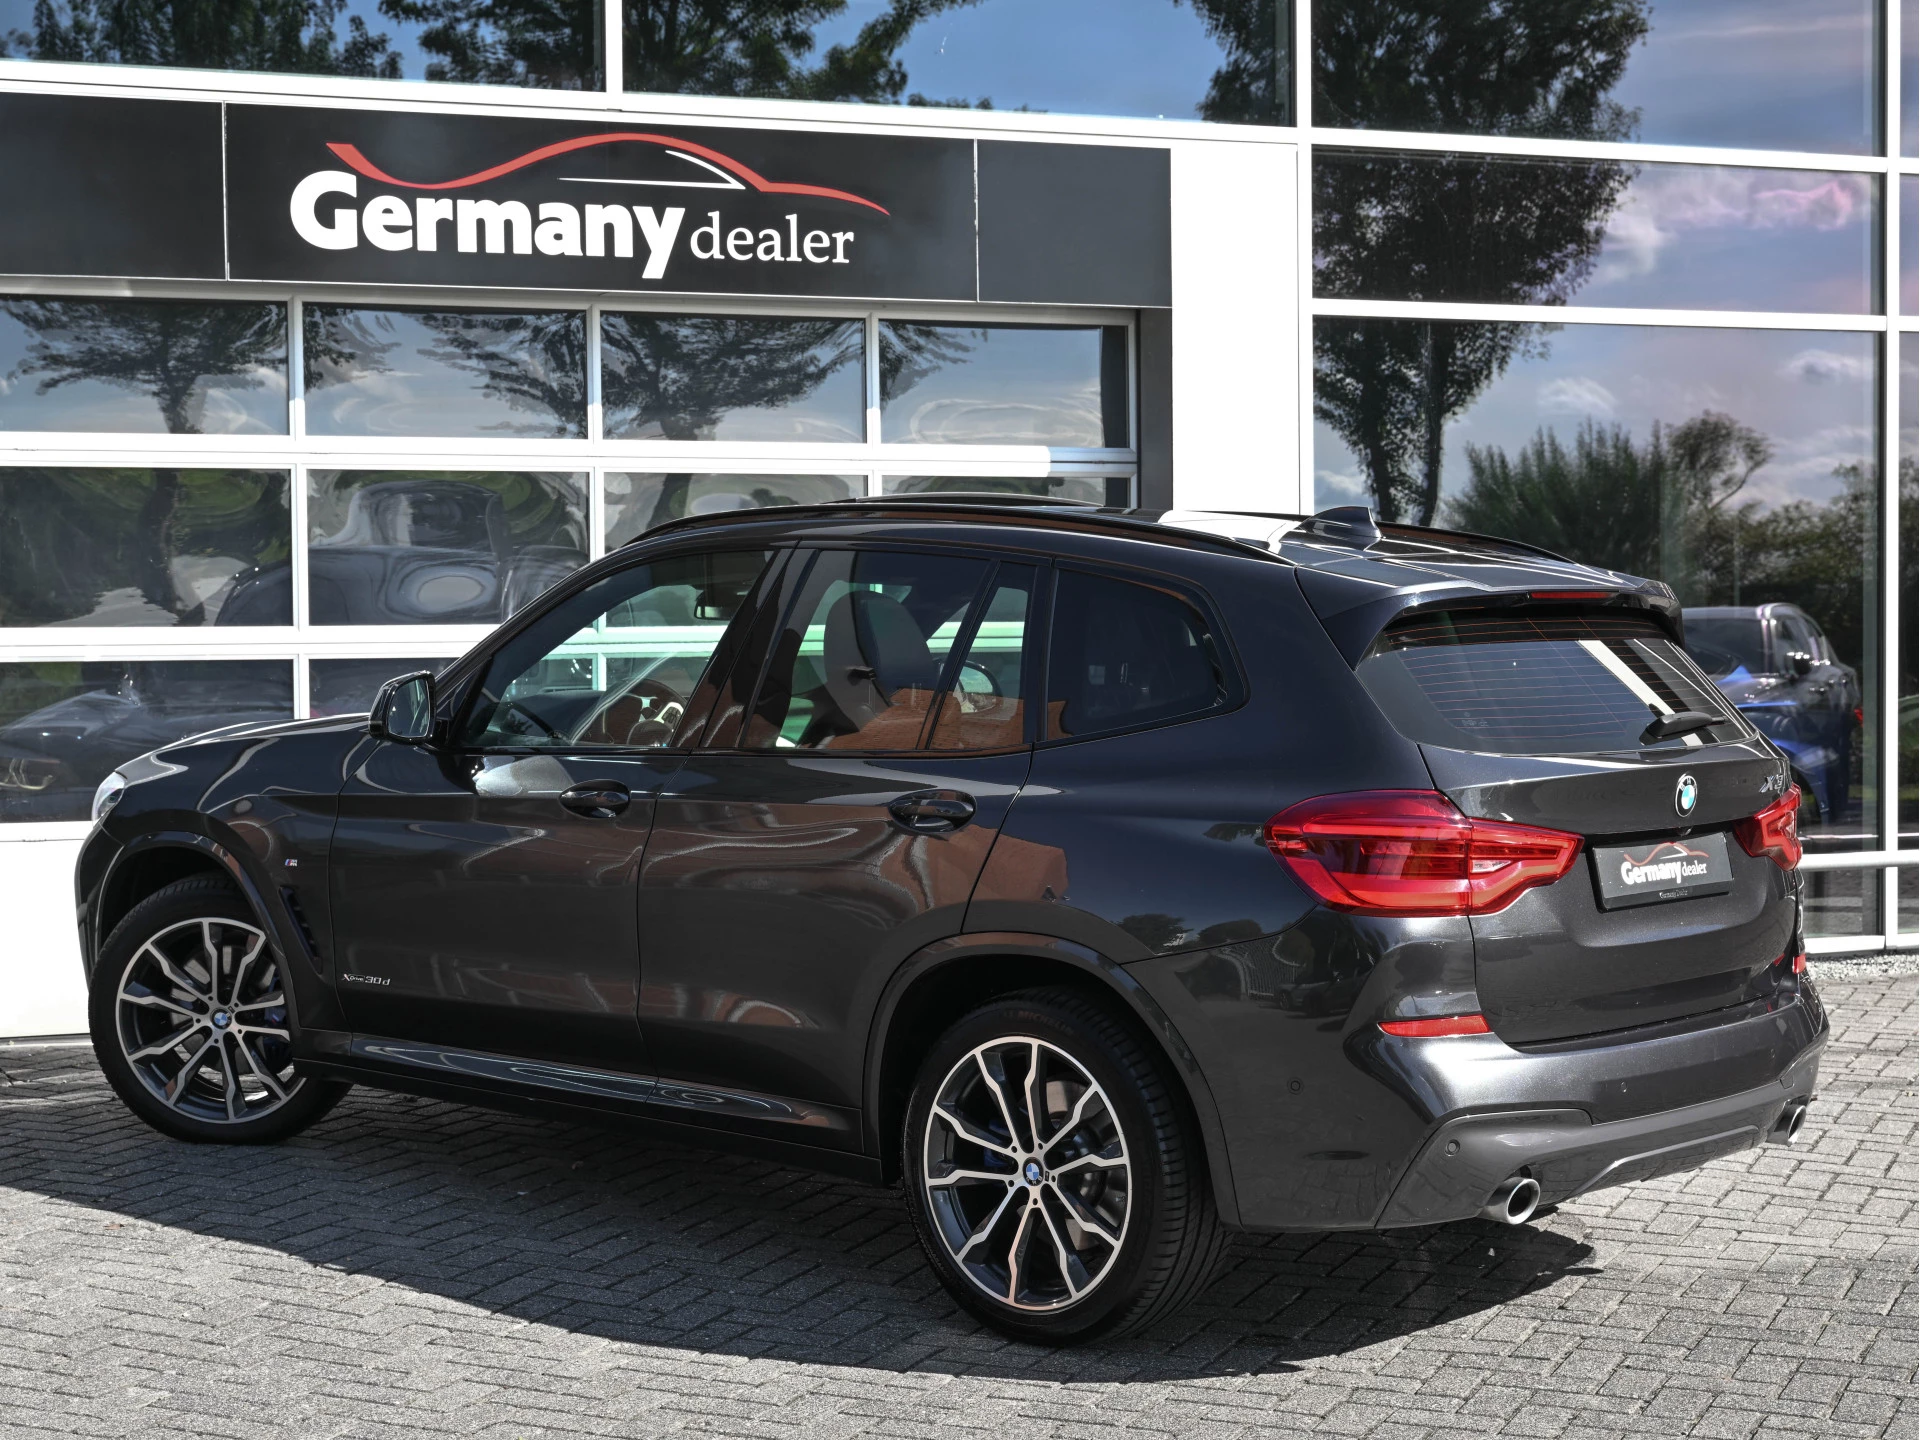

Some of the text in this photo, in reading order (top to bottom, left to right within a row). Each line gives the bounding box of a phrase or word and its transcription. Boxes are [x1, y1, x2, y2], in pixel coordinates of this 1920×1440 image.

[290, 170, 854, 279] Germany dealer
[1620, 860, 1708, 885] Germany dealer
[1017, 1010, 1075, 1037] MICHELIN
